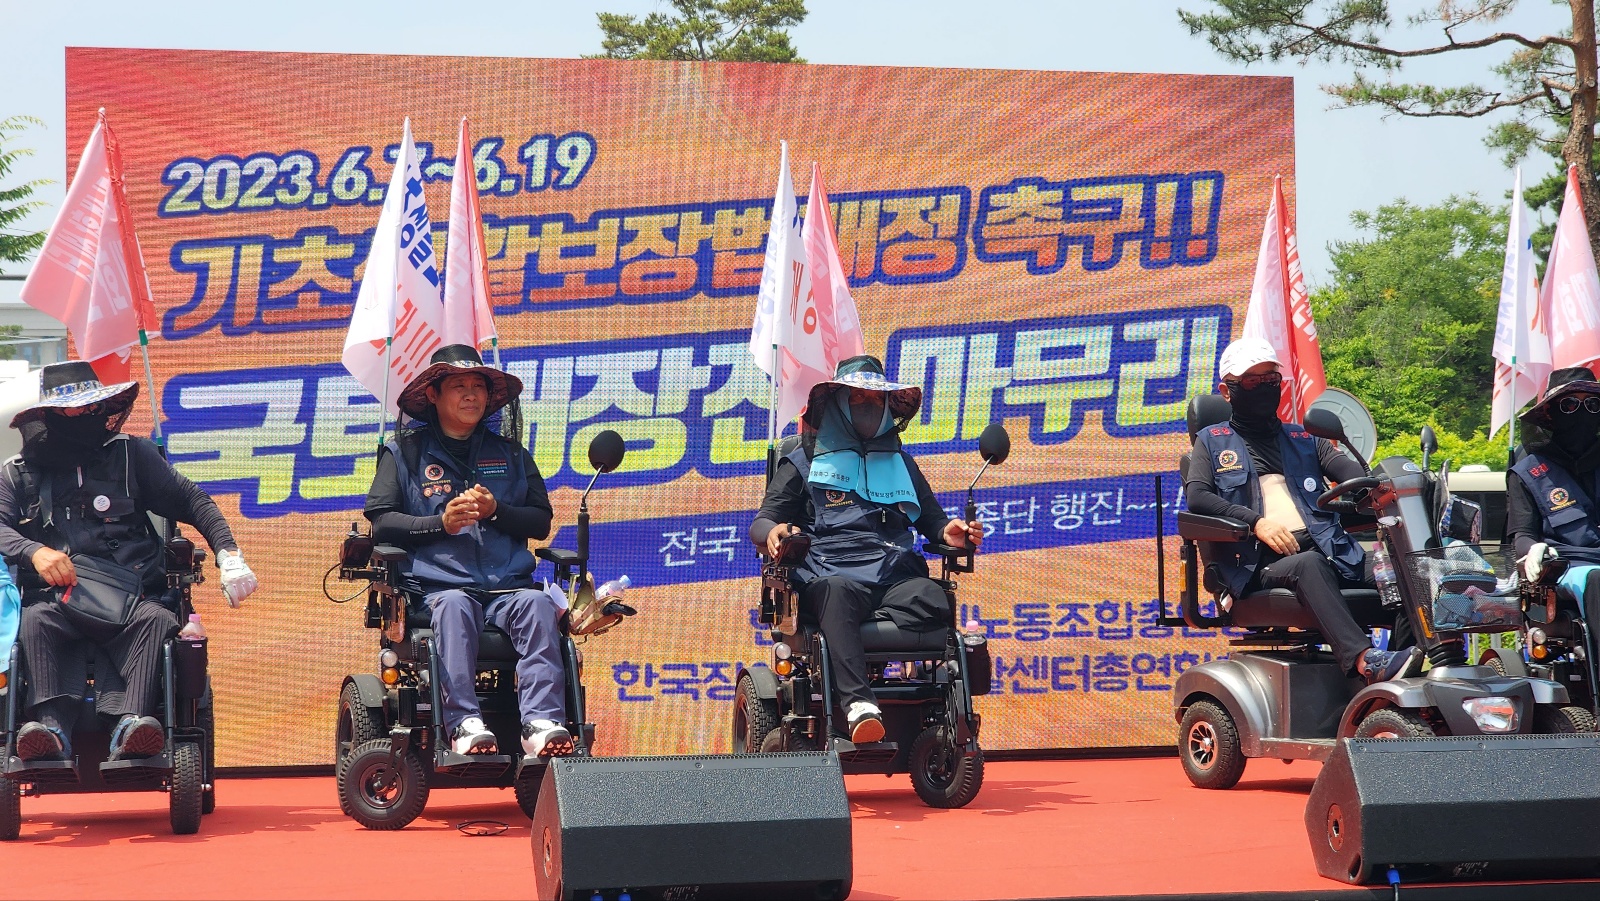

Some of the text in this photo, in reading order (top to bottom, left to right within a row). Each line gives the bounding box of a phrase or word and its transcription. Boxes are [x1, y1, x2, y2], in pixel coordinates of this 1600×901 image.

[980, 178, 1216, 270] 촉구!!
[898, 316, 1220, 444] 마무리
[658, 525, 742, 567] 전국
